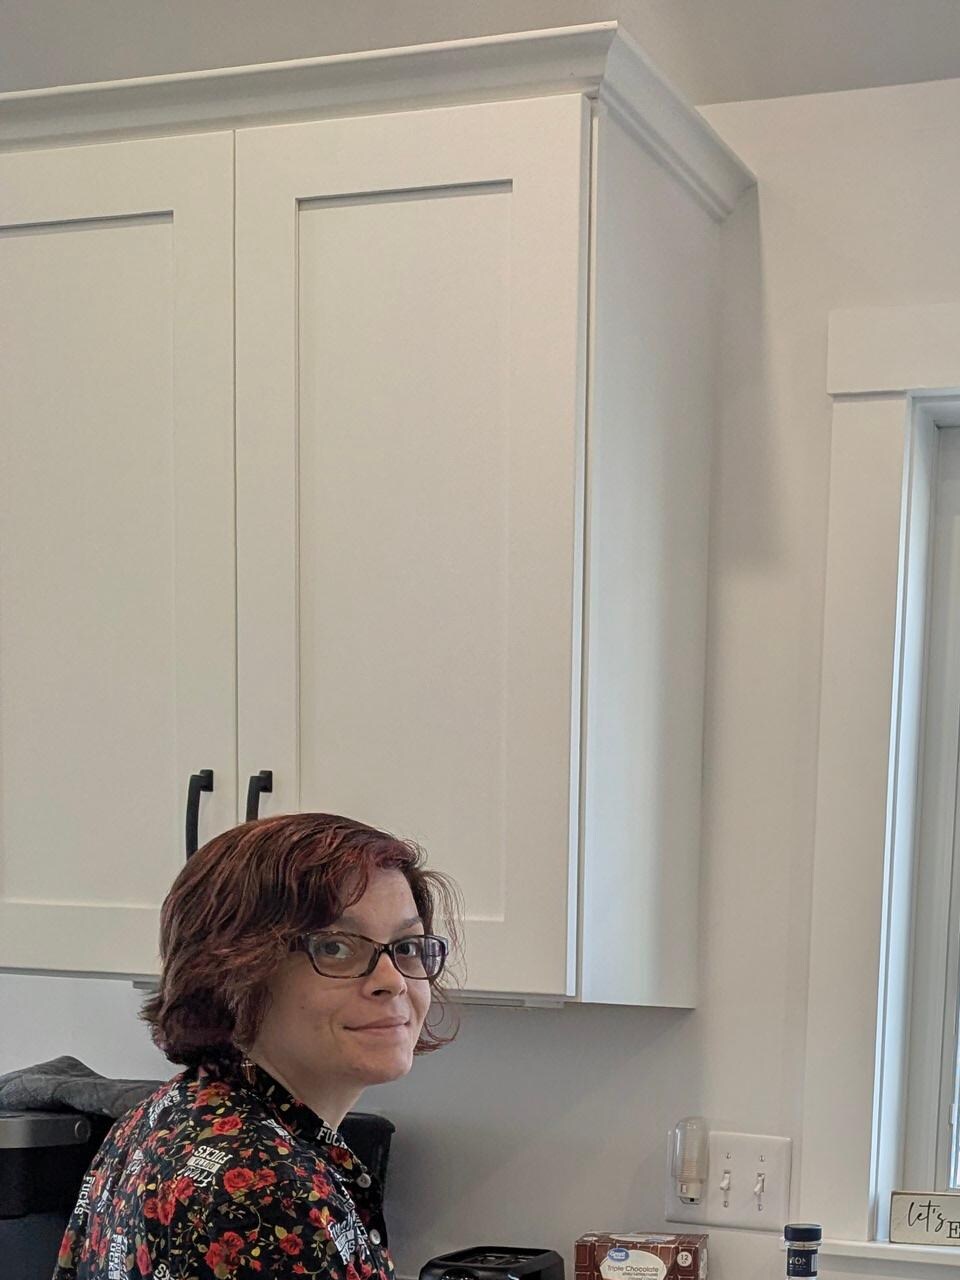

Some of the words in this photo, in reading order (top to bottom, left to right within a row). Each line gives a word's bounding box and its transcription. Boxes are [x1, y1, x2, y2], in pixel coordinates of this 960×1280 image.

[316, 1127, 348, 1148] FUC
[194, 1146, 233, 1164] FUCKS
[74, 1176, 95, 1216] FUCKS
[607, 1265, 624, 1273] Triple
[625, 1265, 659, 1273] Chocolate
